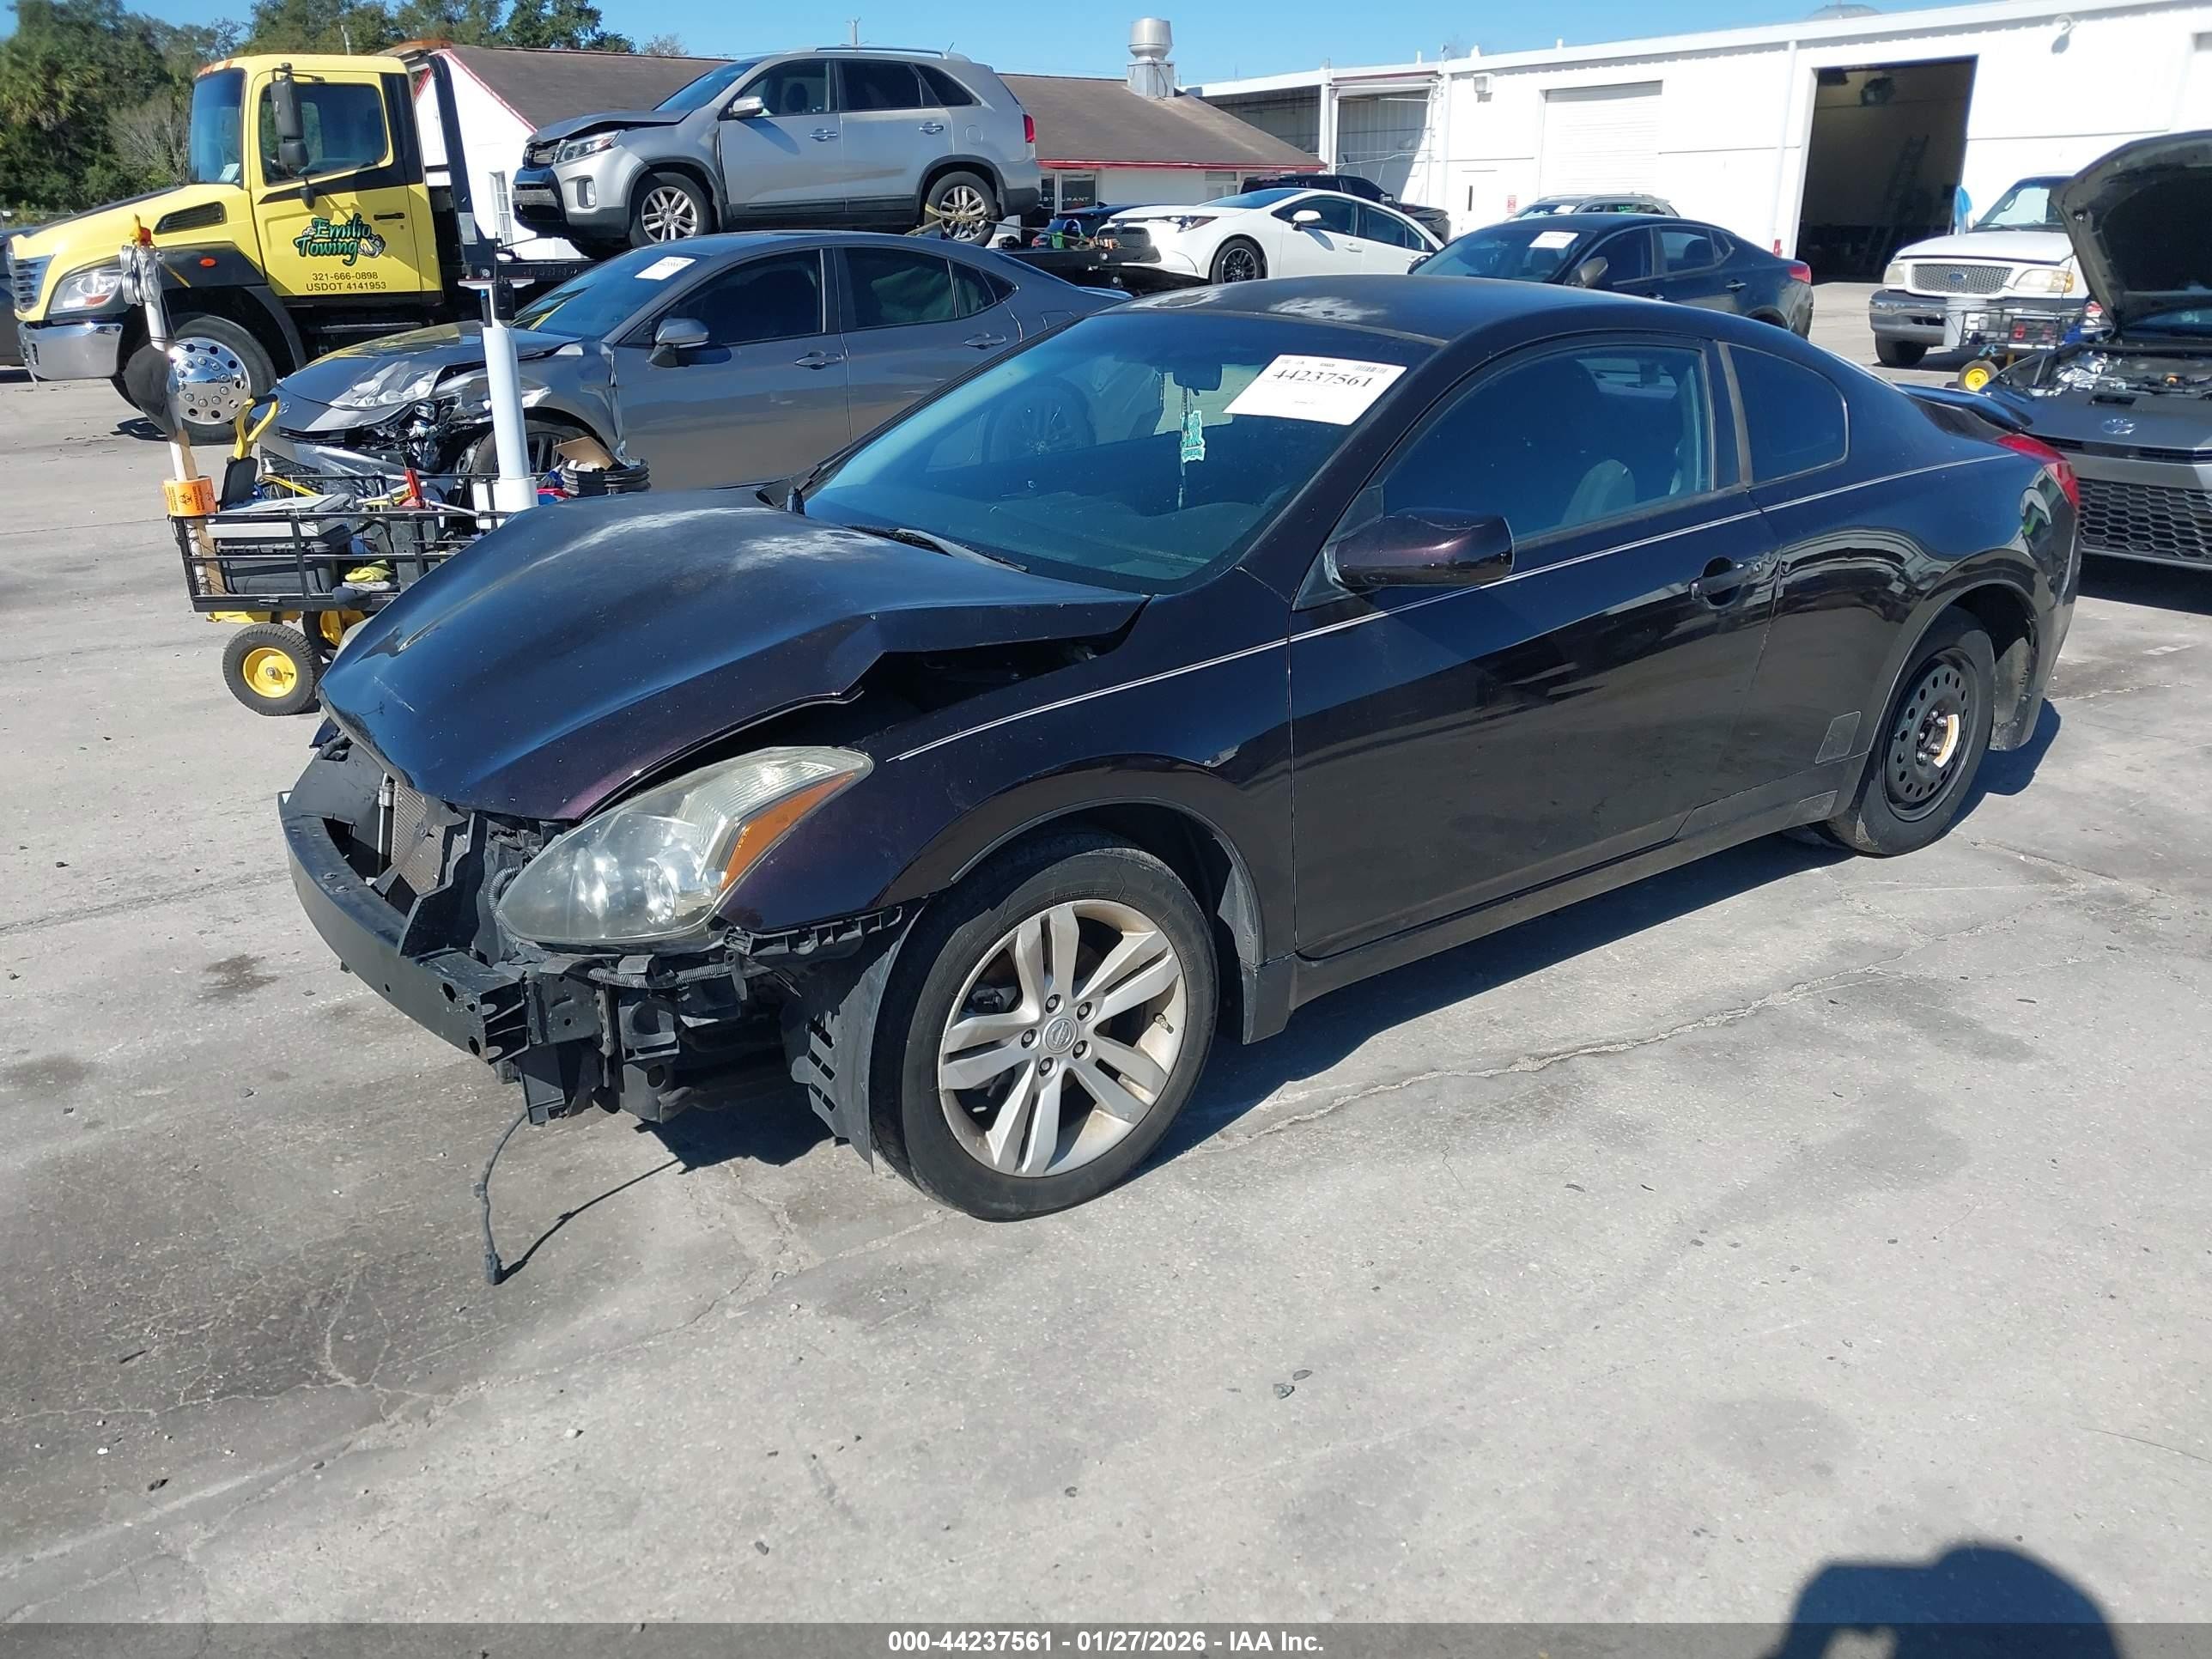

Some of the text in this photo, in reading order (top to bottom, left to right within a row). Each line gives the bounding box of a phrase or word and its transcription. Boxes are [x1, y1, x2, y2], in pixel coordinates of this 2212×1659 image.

[312, 213, 371, 239] Emilio
[294, 236, 357, 265] Towing
[312, 271, 379, 281] 321-666-0898
[306, 281, 386, 292] USDOT 4141953
[1273, 368, 1374, 387] 44237561
